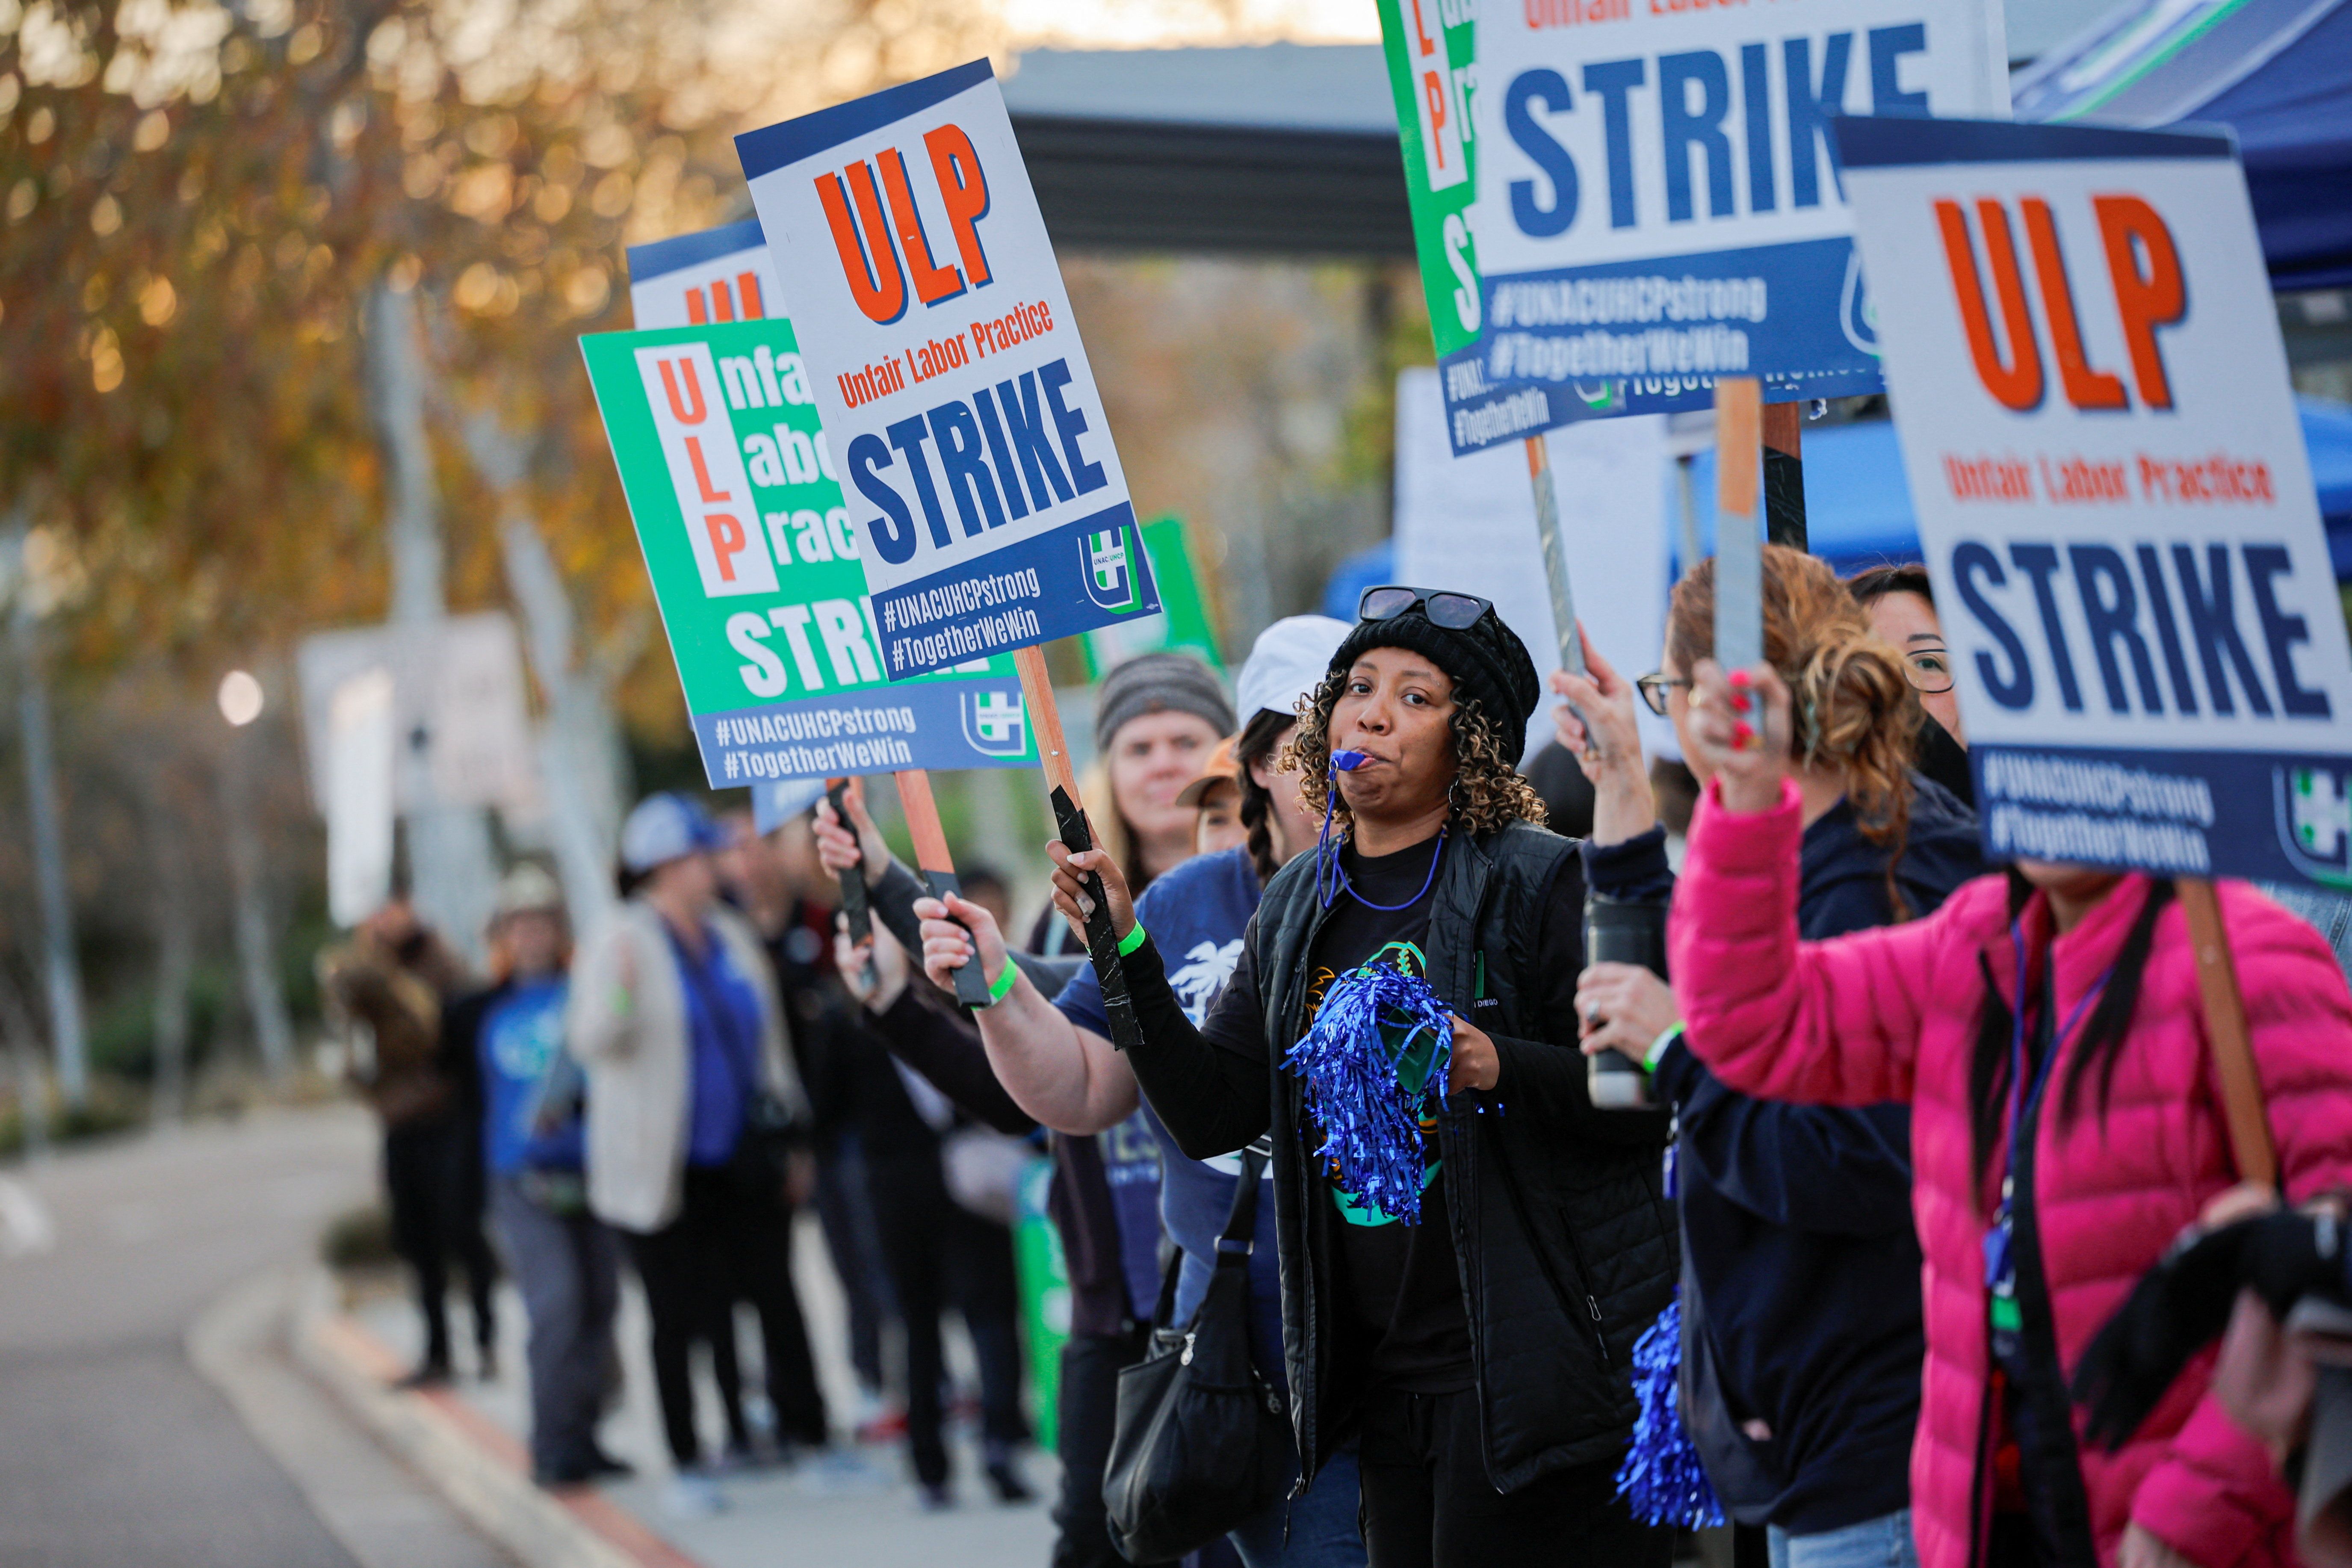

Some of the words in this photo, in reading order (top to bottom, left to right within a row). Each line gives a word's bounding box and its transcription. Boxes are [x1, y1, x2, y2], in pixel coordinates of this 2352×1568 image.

[1505, 22, 1929, 238] STRIKE
[813, 123, 993, 325] ULP
[837, 355, 905, 408] Unfair
[905, 333, 969, 384] Labor
[970, 301, 1053, 358] Practice
[1933, 192, 2187, 411] ULP
[848, 357, 1108, 565] STRIKE
[726, 595, 990, 698] STR
[884, 567, 1040, 633] #UNACUHCPstrong
[892, 606, 1041, 671] #TogetherWeWin
[1952, 541, 2332, 719] STRIKE
[715, 706, 916, 747] #UNACUHCPstrong
[724, 736, 912, 779] #TogetherWeWin
